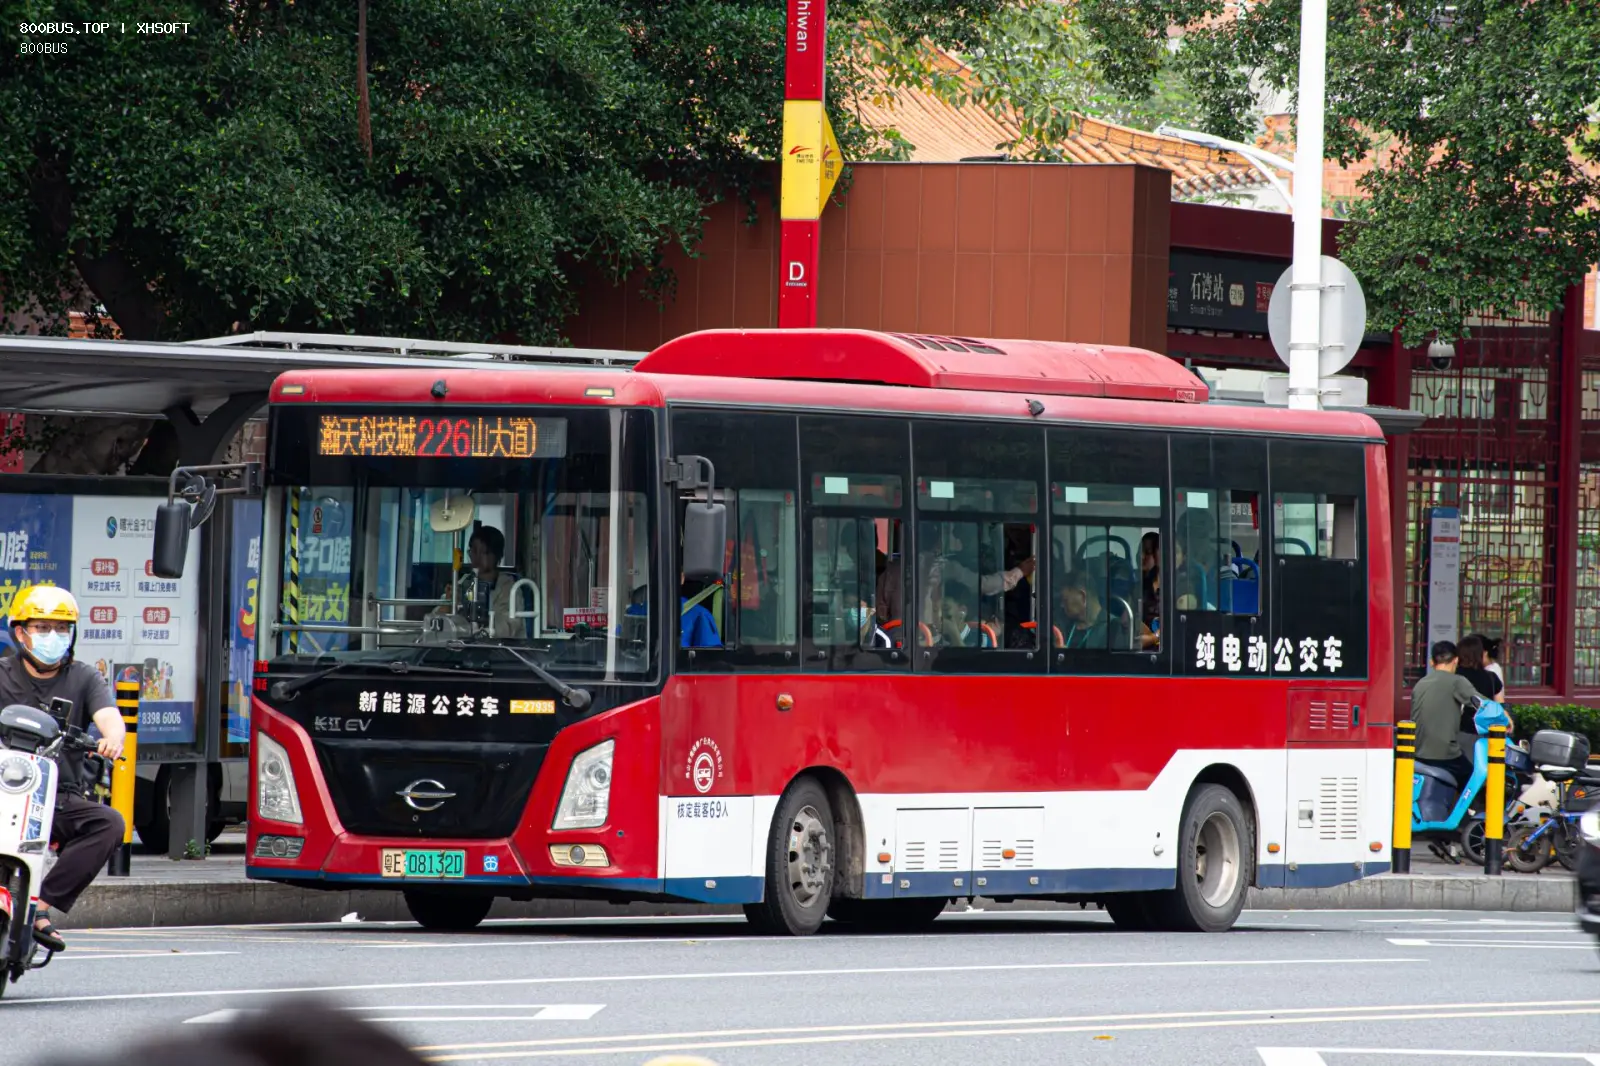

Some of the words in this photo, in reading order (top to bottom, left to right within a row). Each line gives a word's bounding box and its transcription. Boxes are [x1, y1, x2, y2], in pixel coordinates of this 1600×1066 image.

[789, 261, 804, 281] D
[1190, 271, 1224, 302] 石湾站
[320, 416, 416, 456] 瀚天科技城
[416, 418, 471, 457] 226
[1195, 632, 1343, 673] 纯电动公交车
[358, 691, 499, 718] 新能源公交车
[511, 701, 554, 713] F-27935
[142, 711, 160, 725] 8398
[162, 711, 181, 725] 6006
[314, 716, 342, 732] 长江
[344, 718, 372, 732] EV
[677, 800, 729, 818] 核定载客69人
